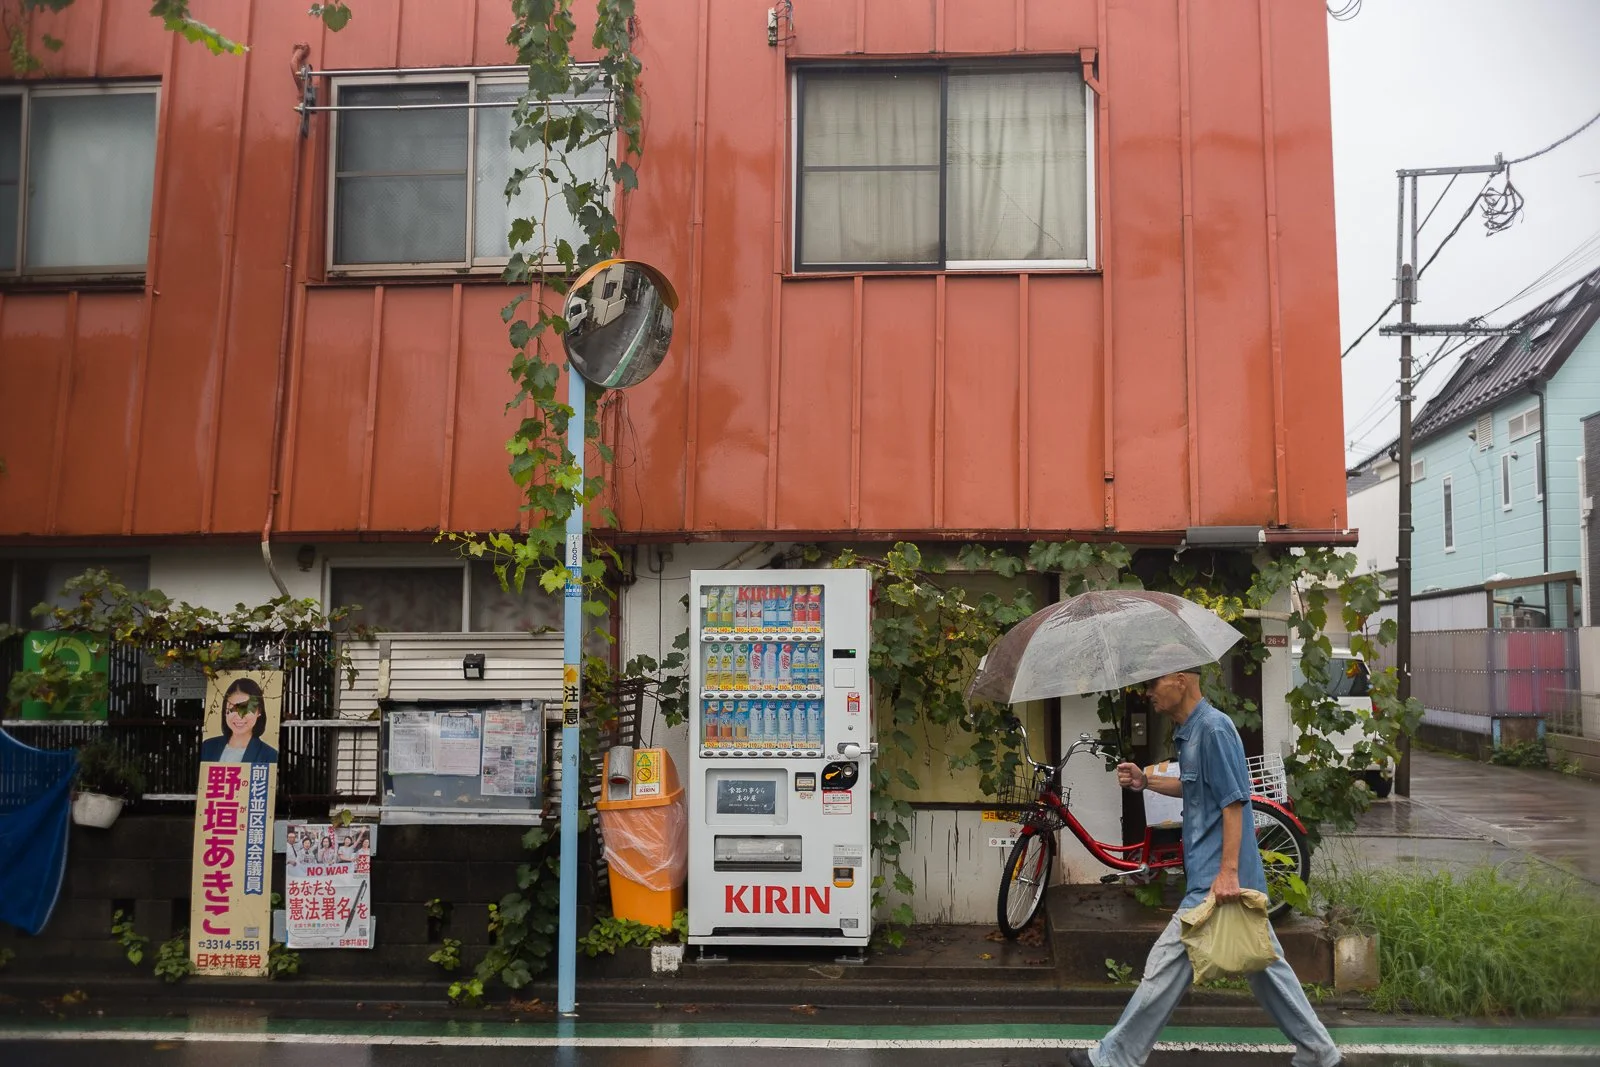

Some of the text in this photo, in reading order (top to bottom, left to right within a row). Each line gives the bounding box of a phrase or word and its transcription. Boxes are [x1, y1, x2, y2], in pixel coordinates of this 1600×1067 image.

[738, 586, 787, 601] KIRIN
[564, 685, 579, 725] 注意
[239, 780, 249, 831] のがき
[246, 765, 267, 892] 前杉並区議会議員
[203, 766, 241, 935] 野垣あきこ
[307, 865, 348, 877] NO WAR
[289, 880, 336, 896] あなたも
[725, 885, 830, 914] KIRIN
[206, 939, 260, 951] 3314-5551
[196, 953, 261, 969] 日本共産党
